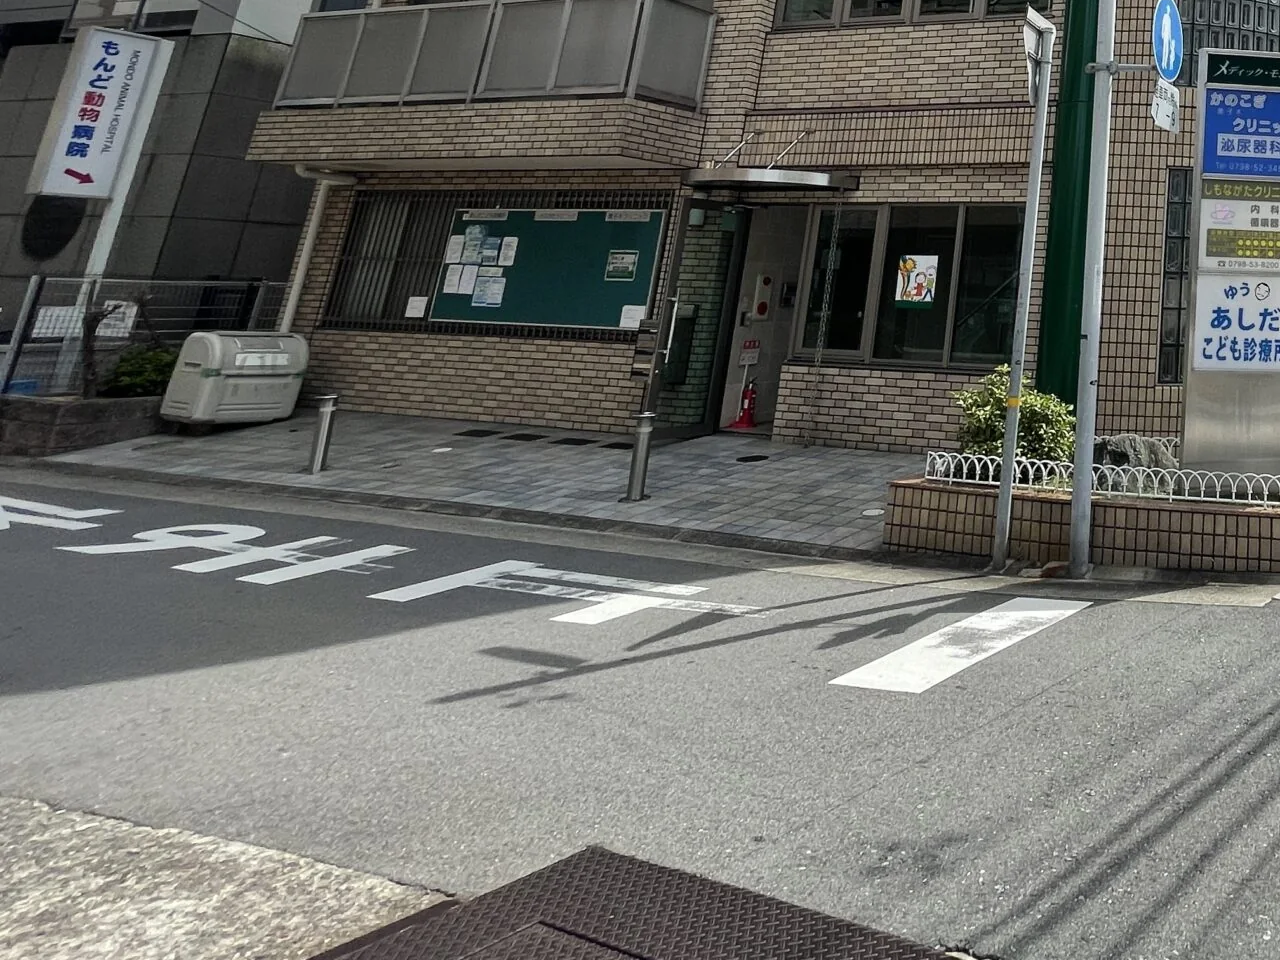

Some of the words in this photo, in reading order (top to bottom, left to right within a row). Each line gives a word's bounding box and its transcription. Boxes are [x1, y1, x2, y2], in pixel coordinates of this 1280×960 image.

[124, 50, 141, 81] MONDO
[112, 83, 131, 112] ANIMAL
[1210, 91, 1267, 109] かのこぎ
[101, 114, 122, 154] HOSPITAL
[1224, 282, 1250, 300] ゆう
[1210, 307, 1280, 332] あしだ
